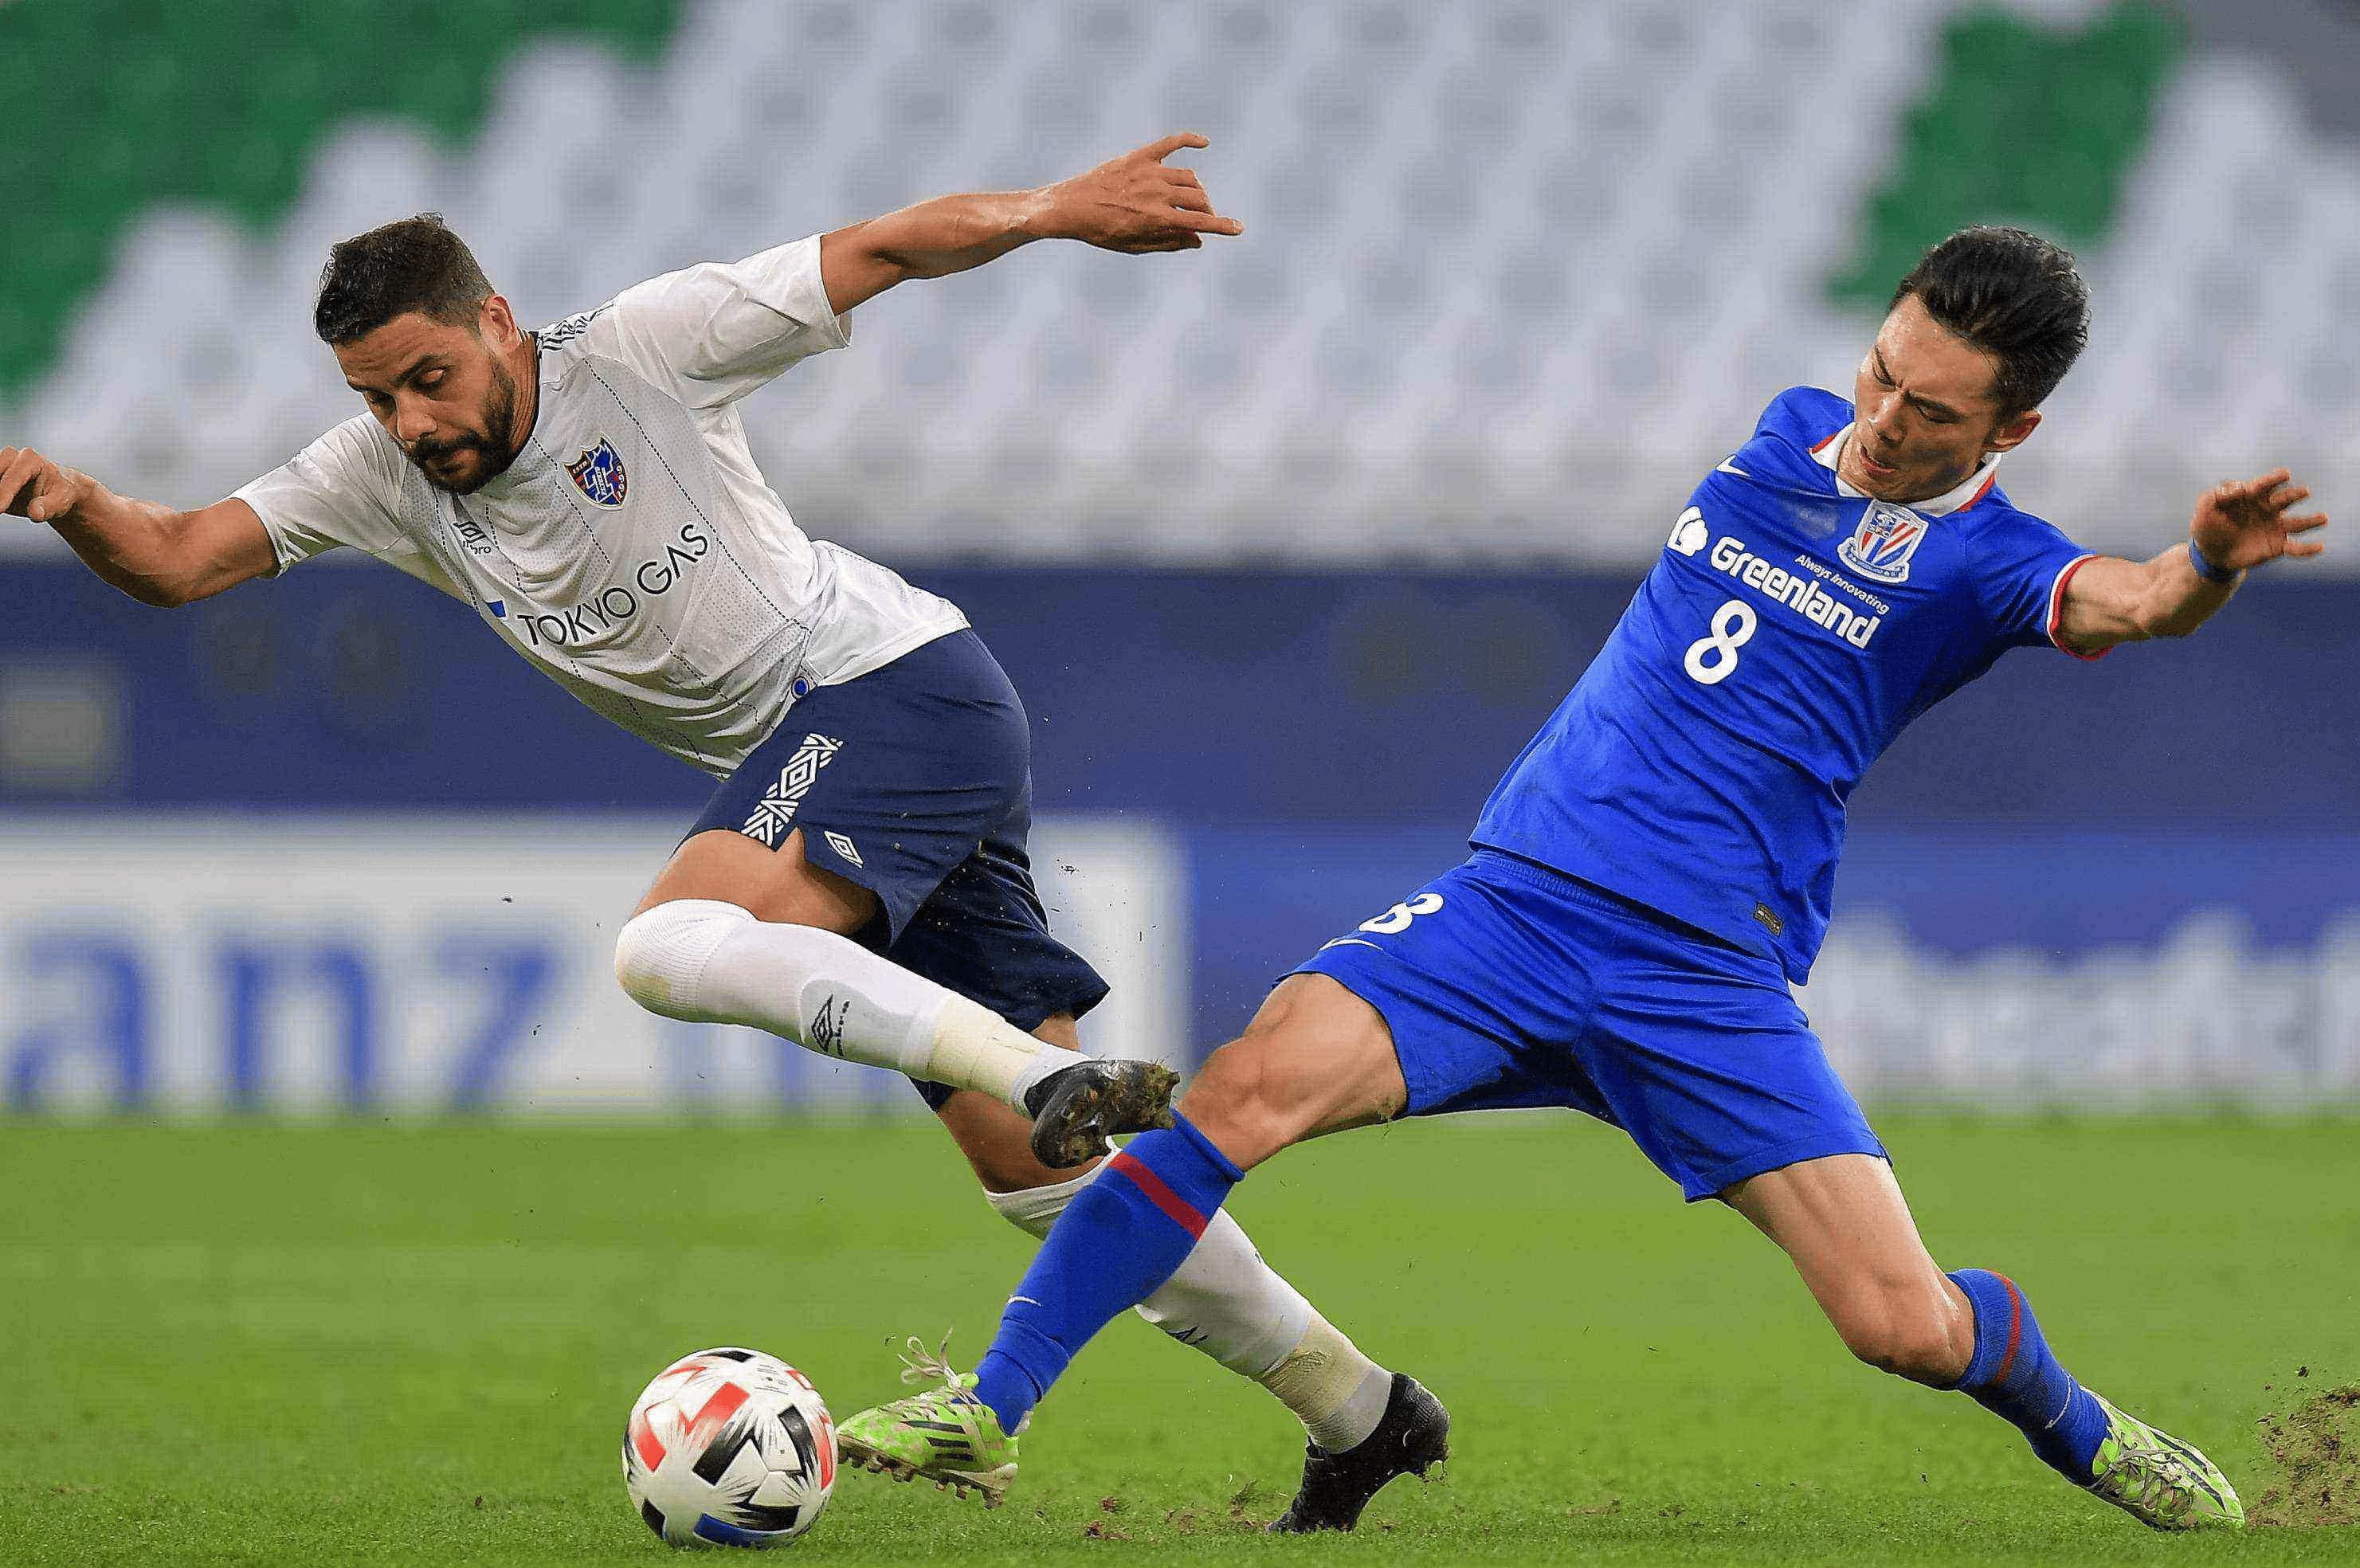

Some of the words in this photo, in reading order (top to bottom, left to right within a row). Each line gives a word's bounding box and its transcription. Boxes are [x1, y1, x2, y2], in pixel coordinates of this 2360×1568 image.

[517, 586, 637, 645] TOKYO
[637, 523, 708, 596] GAS
[1710, 536, 1880, 649] Greenland
[1794, 555, 1833, 579] Always
[1684, 599, 1758, 685] 8
